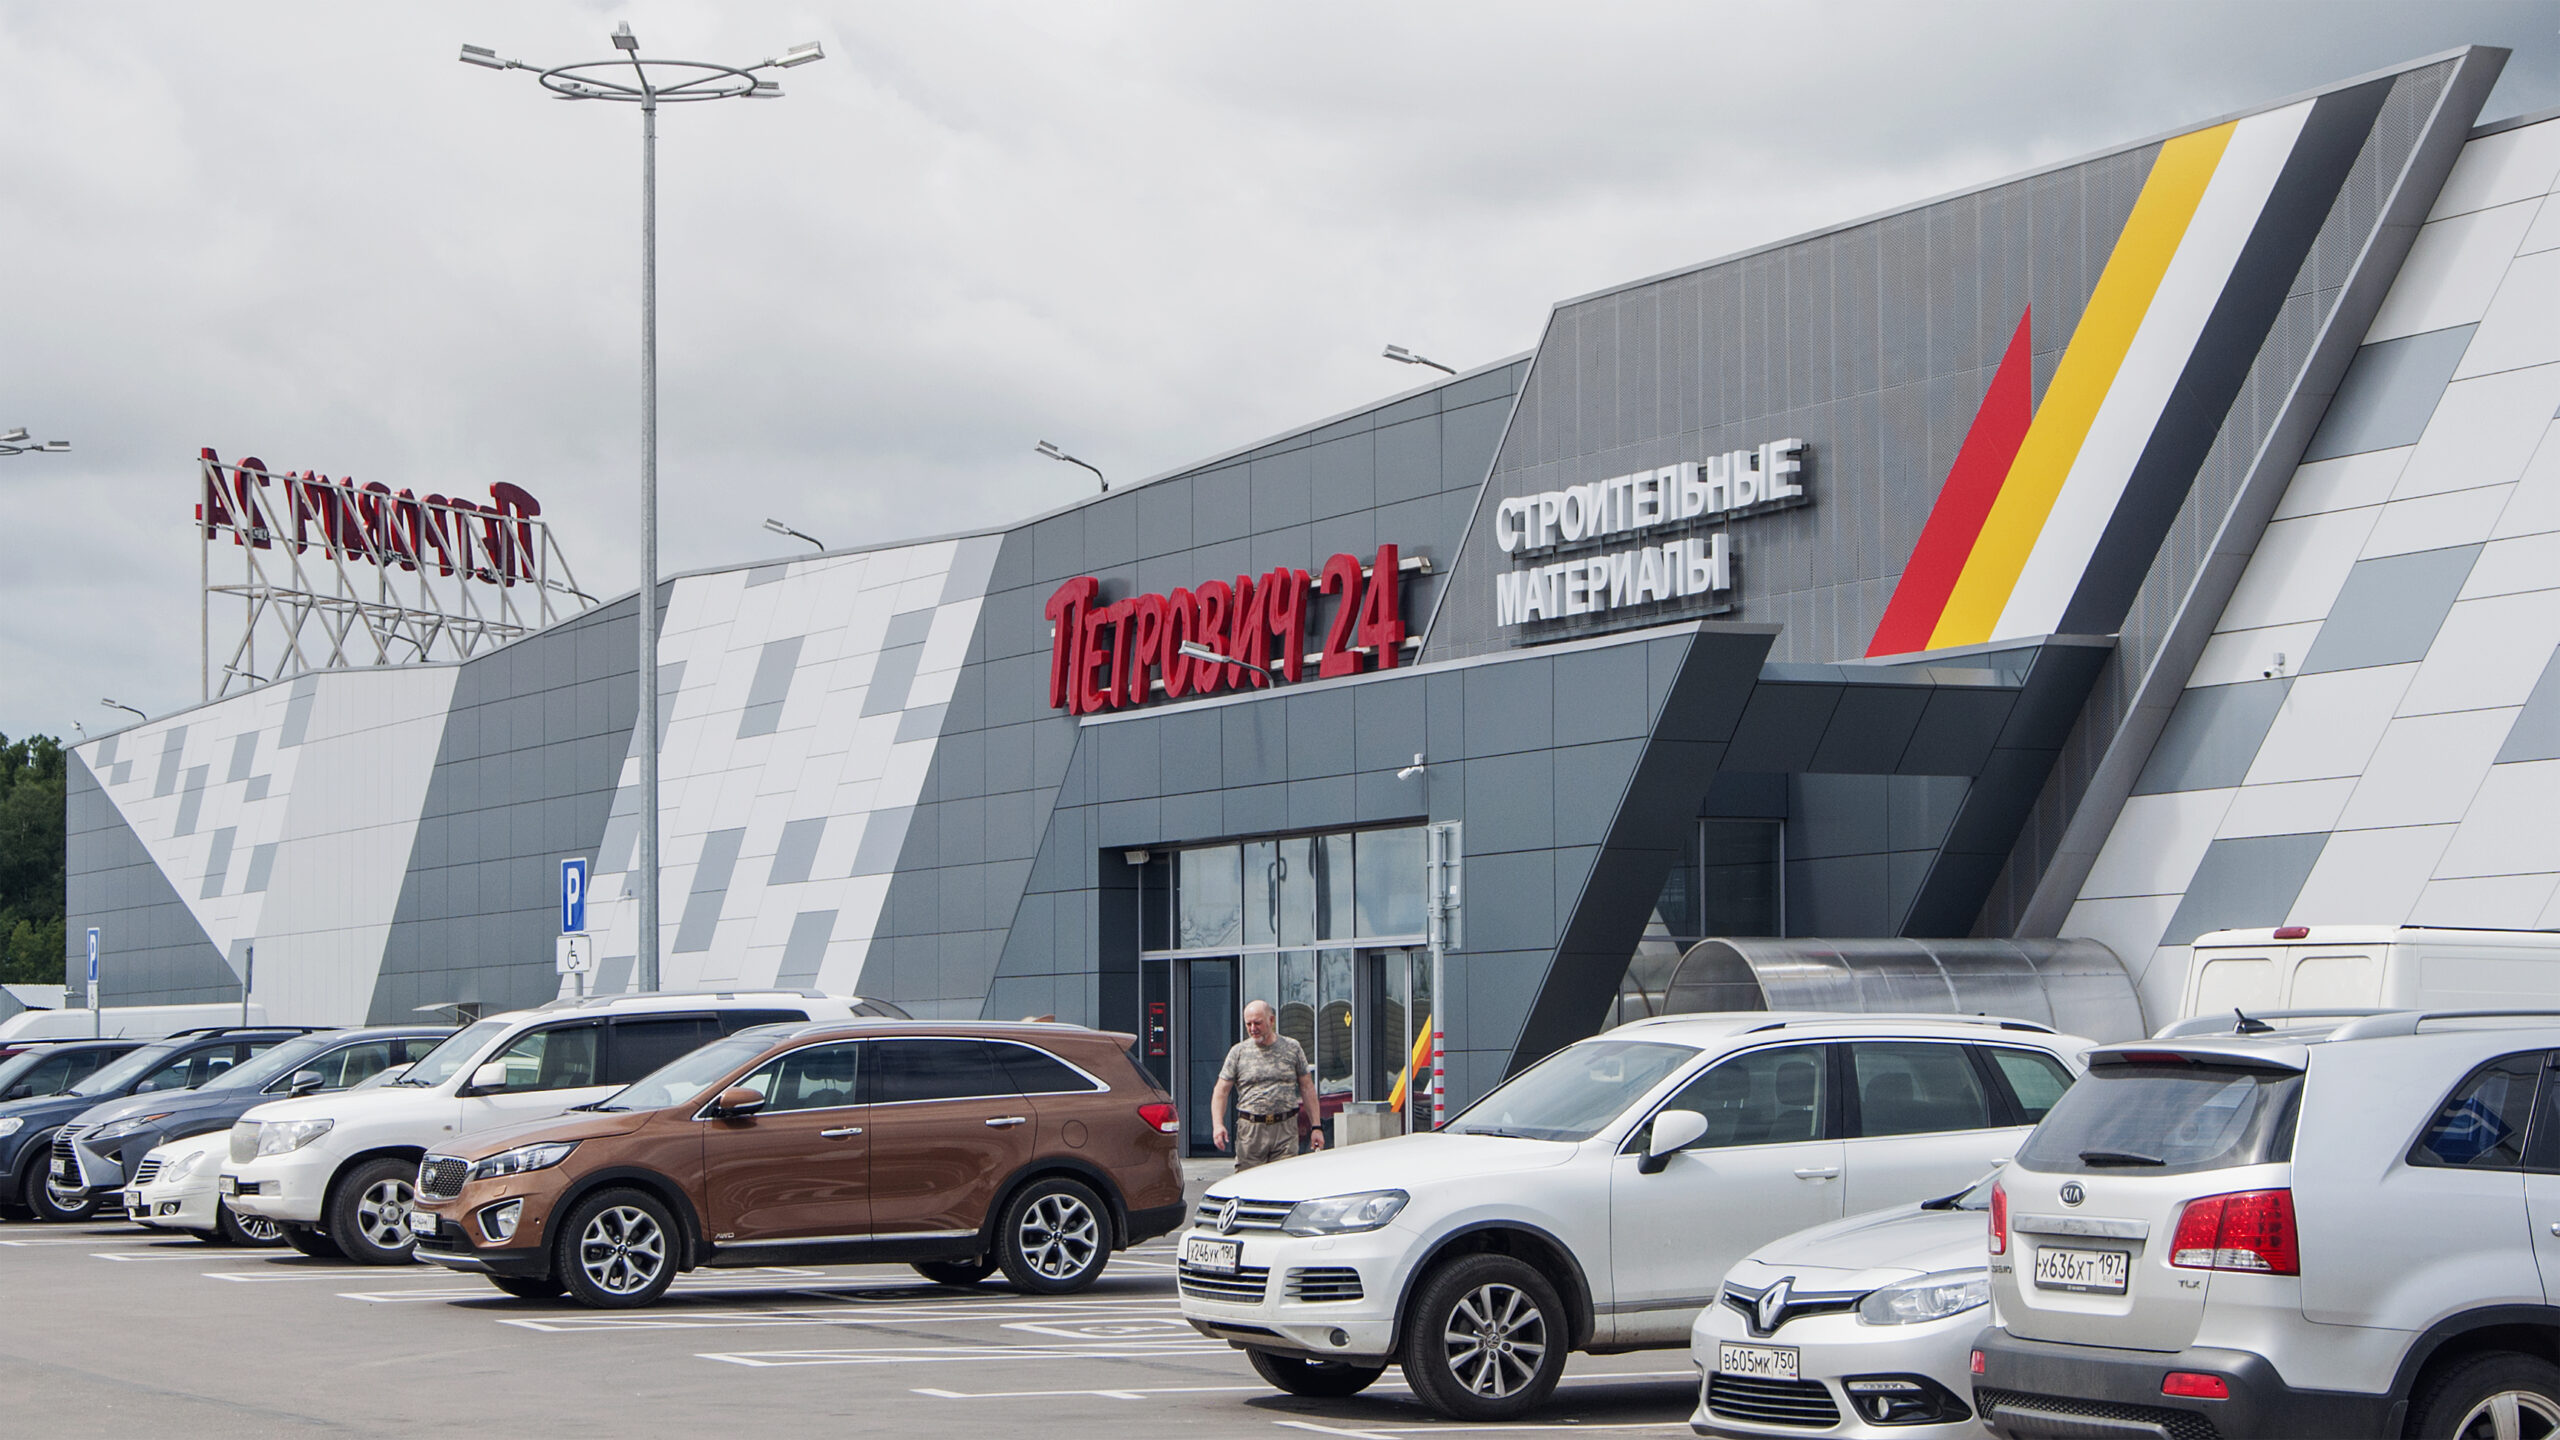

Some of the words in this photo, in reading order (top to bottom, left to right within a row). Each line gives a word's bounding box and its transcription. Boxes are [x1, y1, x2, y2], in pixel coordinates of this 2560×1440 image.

[1496, 438, 1802, 552] СТРОИТЕЛЬНЫЕ
[1497, 533, 1730, 626] МАТЕРИАЛЫ
[1045, 567, 1310, 715] ПЕТРОВИЧ
[1319, 544, 1405, 678] 24
[567, 867, 581, 926] P
[89, 934, 97, 977] P
[2062, 1187, 2081, 1201] KIA
[1221, 1245, 1235, 1260] 190
[2099, 1254, 2121, 1275] 197
[1724, 1350, 1770, 1374] В605МК
[1774, 1351, 1794, 1369] 750
